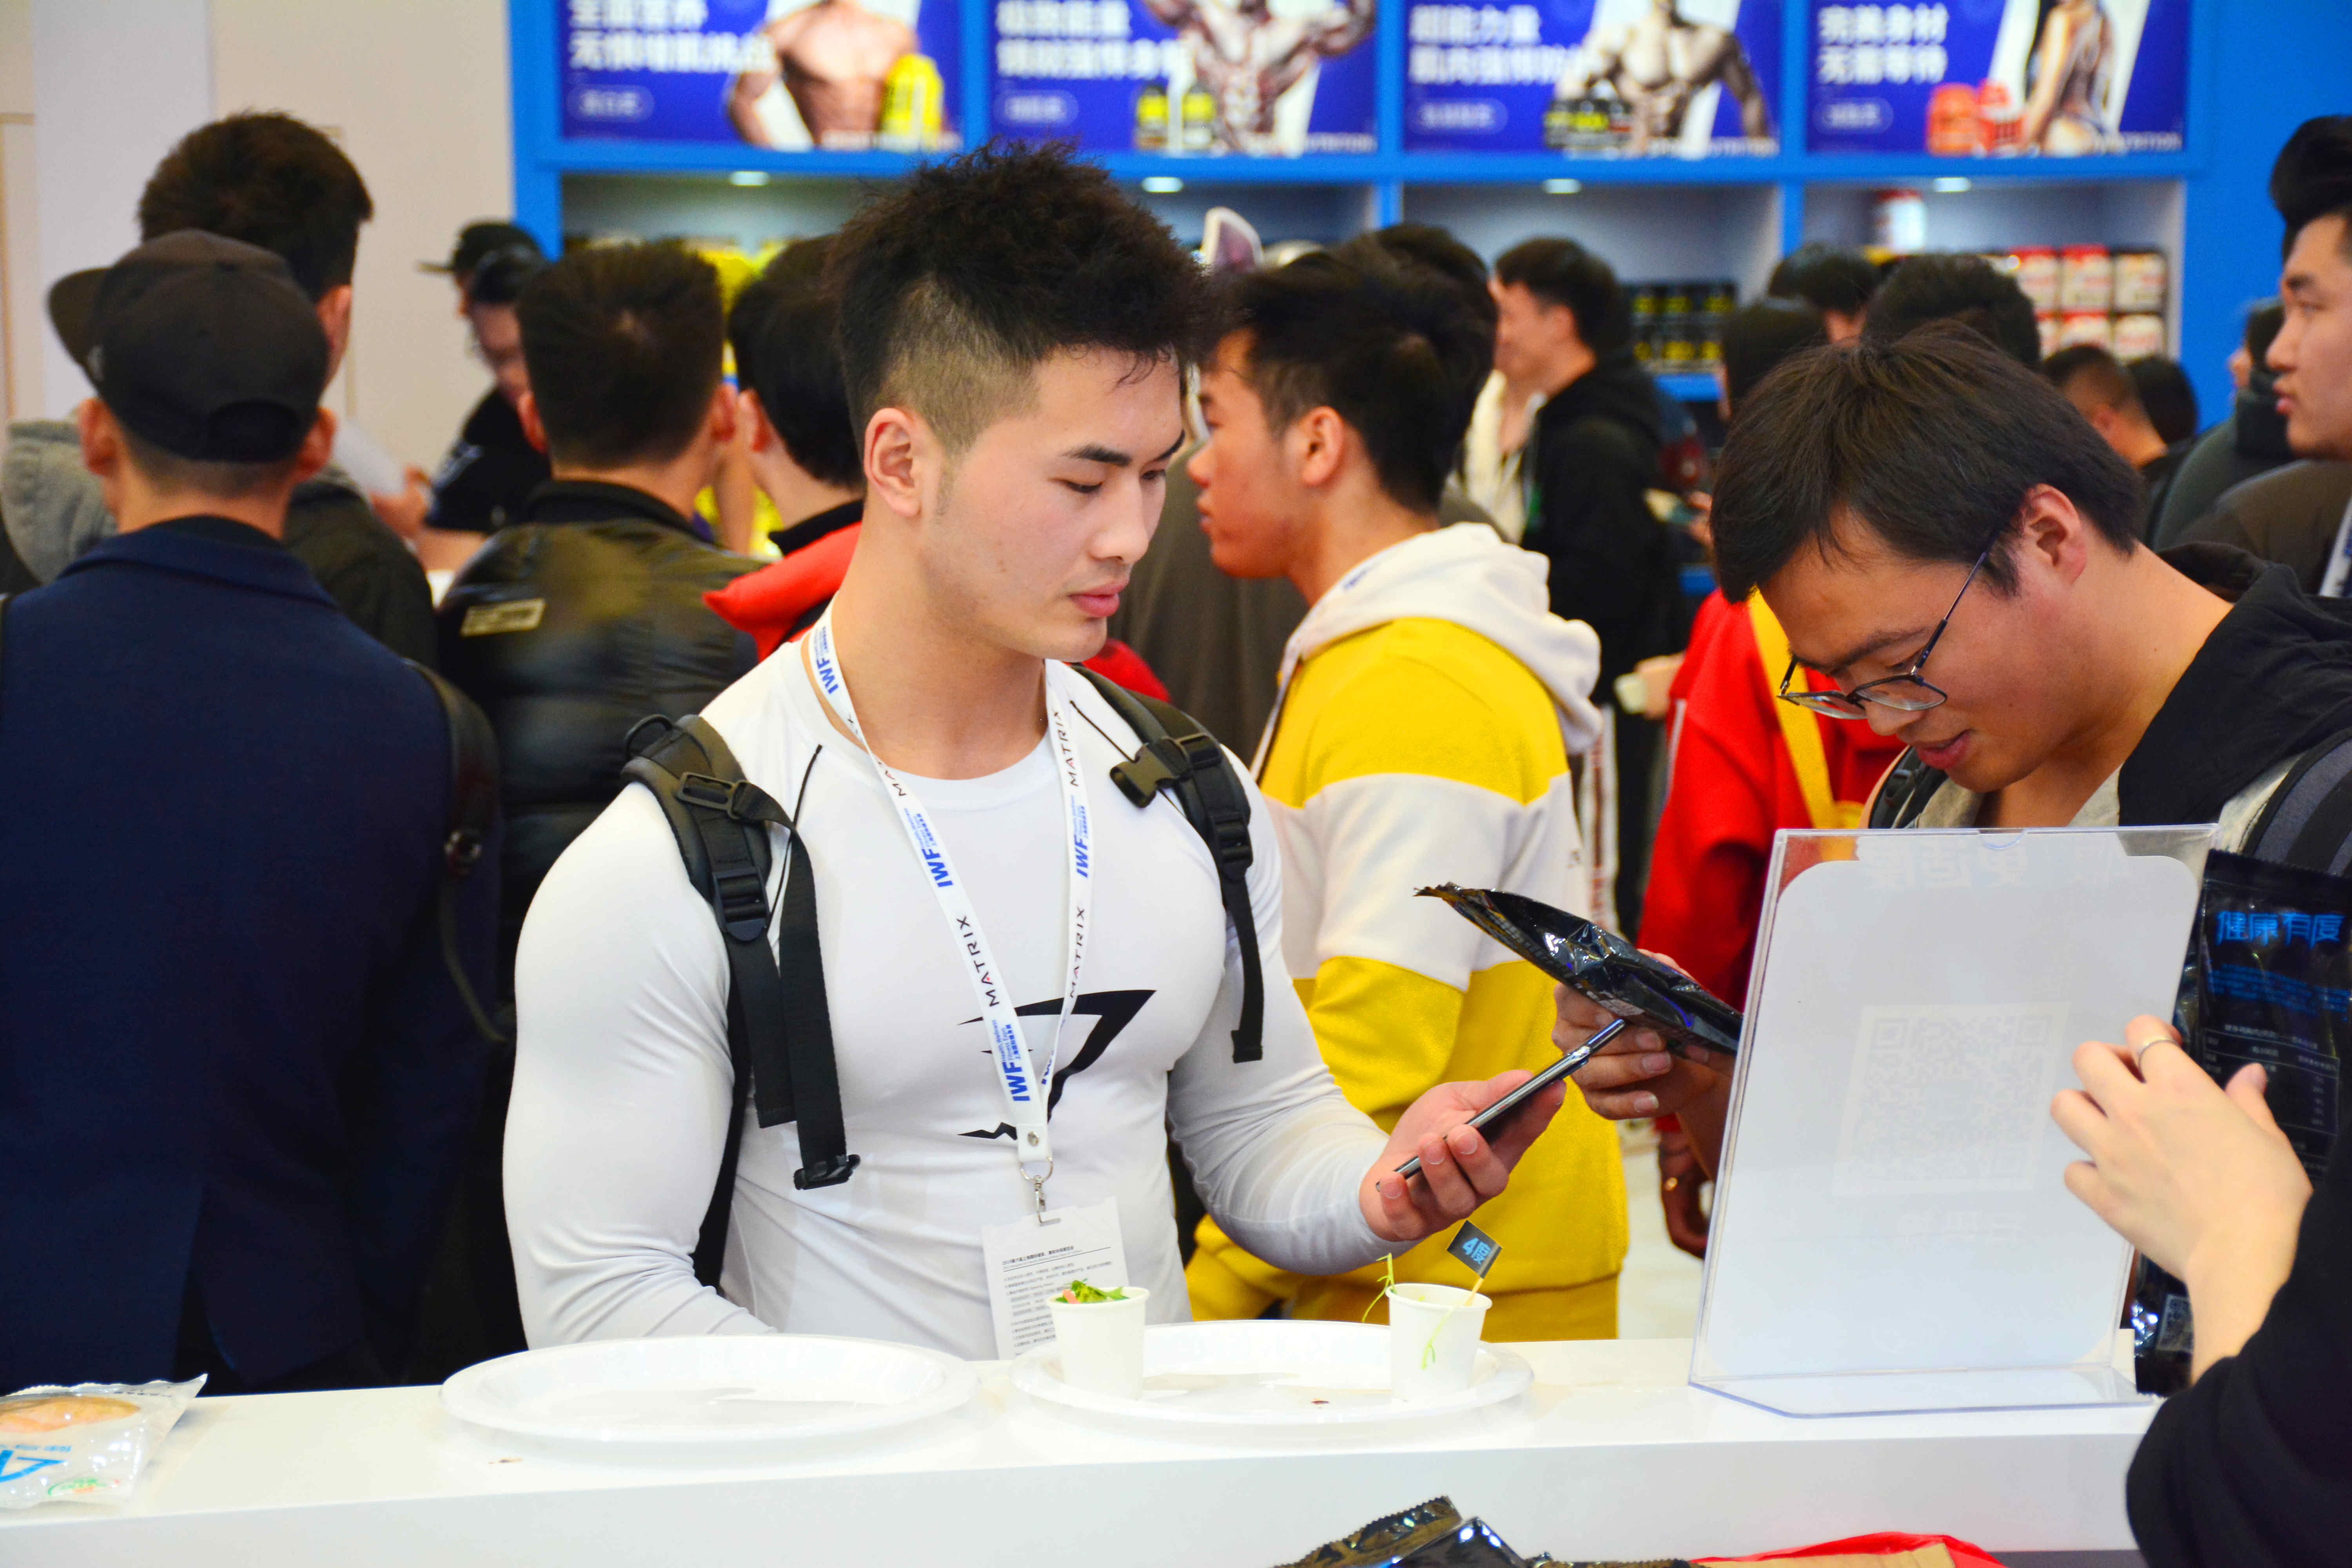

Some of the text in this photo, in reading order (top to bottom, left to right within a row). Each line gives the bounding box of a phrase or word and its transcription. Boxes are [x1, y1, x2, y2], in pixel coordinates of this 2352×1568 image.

[817, 658, 838, 694] IWF
[1052, 711, 1079, 786] MATRIX
[922, 848, 953, 887] IWF
[1074, 835, 1089, 878] IWF
[2216, 911, 2345, 949] 健康有度
[956, 915, 1000, 1007] MATRIX
[1070, 906, 1085, 998] MATRIX
[1002, 1061, 1030, 1101] IWF
[1462, 1237, 1491, 1265] 4度
